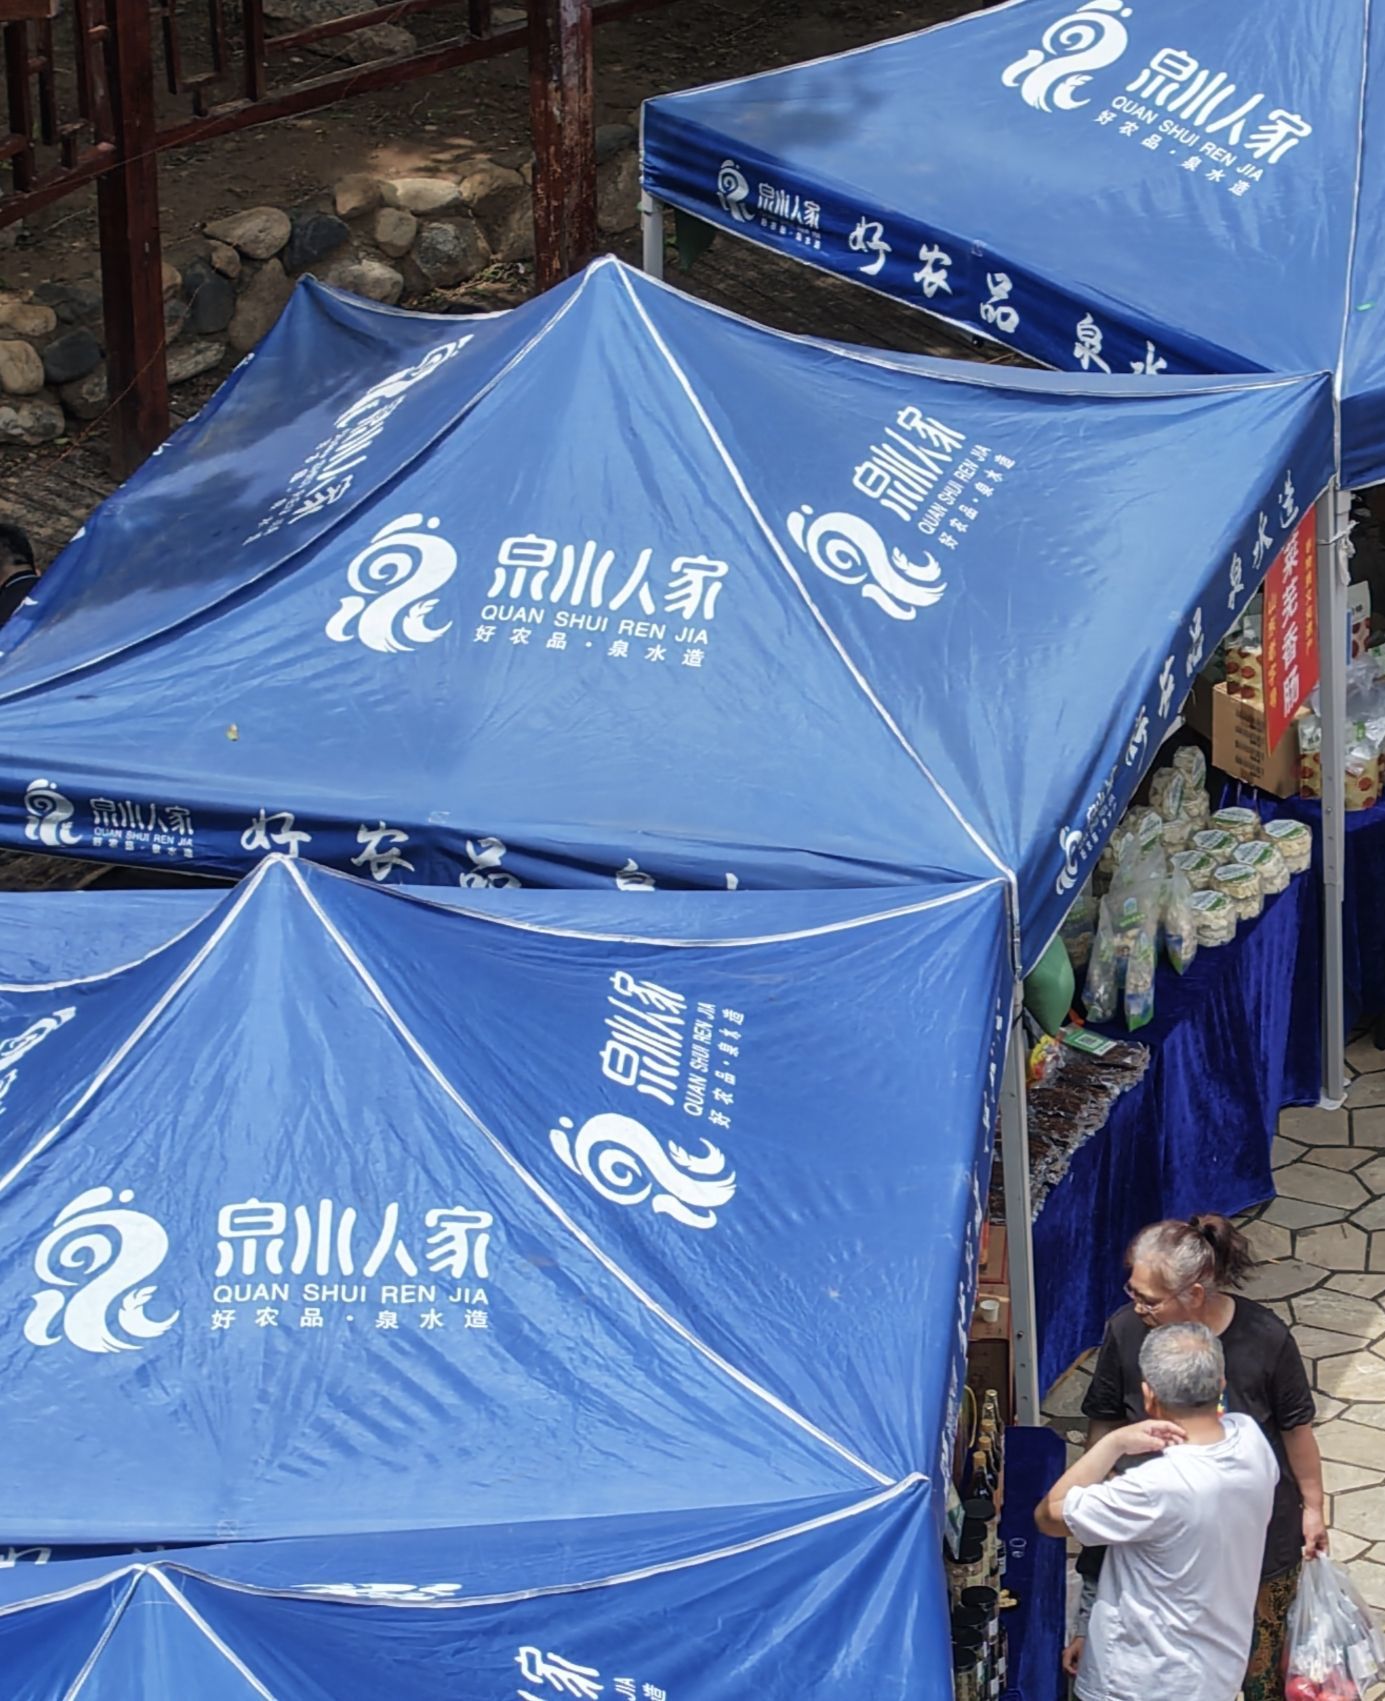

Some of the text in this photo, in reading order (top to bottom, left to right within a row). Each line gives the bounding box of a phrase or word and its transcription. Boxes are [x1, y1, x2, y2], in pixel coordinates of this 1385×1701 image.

[1112, 96, 1264, 181] QUAN SHUI REN JIA
[1126, 48, 1312, 164] 泉水人家
[757, 183, 821, 229] 泉水人家
[849, 216, 1020, 334] 好农品
[853, 406, 966, 522] 泉水人家
[918, 445, 992, 535] QUAN SHUI REN JIA
[487, 534, 729, 620] 泉水人家
[481, 605, 708, 644] QUAN SHUI REN JIA
[89, 797, 194, 835] 泉水人家
[94, 827, 193, 848] QUAN SHUI REN JIA
[599, 970, 687, 1106] 泉水人家
[683, 1002, 716, 1117] QUAN SHUI REN JIA
[215, 1197, 493, 1279] 泉水人家
[213, 1284, 489, 1305] QUAN SHUI REN JIA
[514, 1646, 604, 1701] 家
